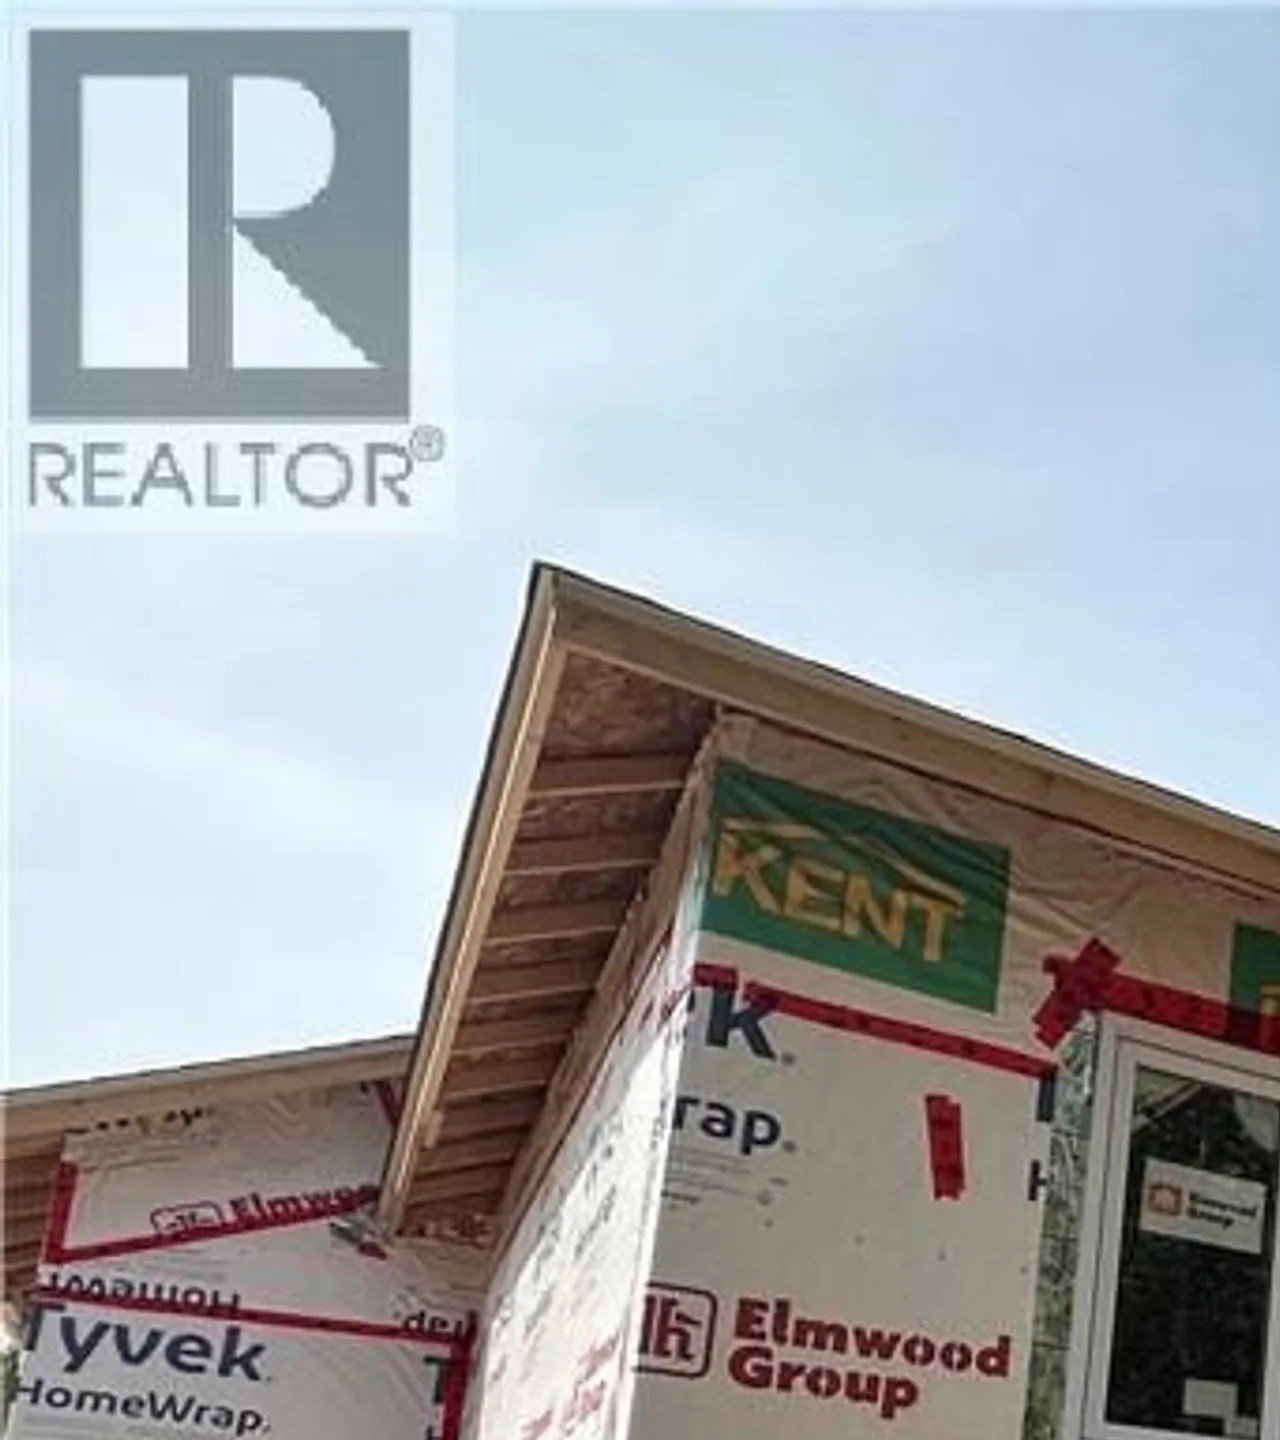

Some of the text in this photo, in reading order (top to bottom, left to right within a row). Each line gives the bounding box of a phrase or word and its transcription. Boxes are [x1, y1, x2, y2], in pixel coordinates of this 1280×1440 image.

[711, 826, 963, 963] KENT
[732, 1297, 1012, 1378] Elmwood
[727, 1346, 920, 1419] Group
